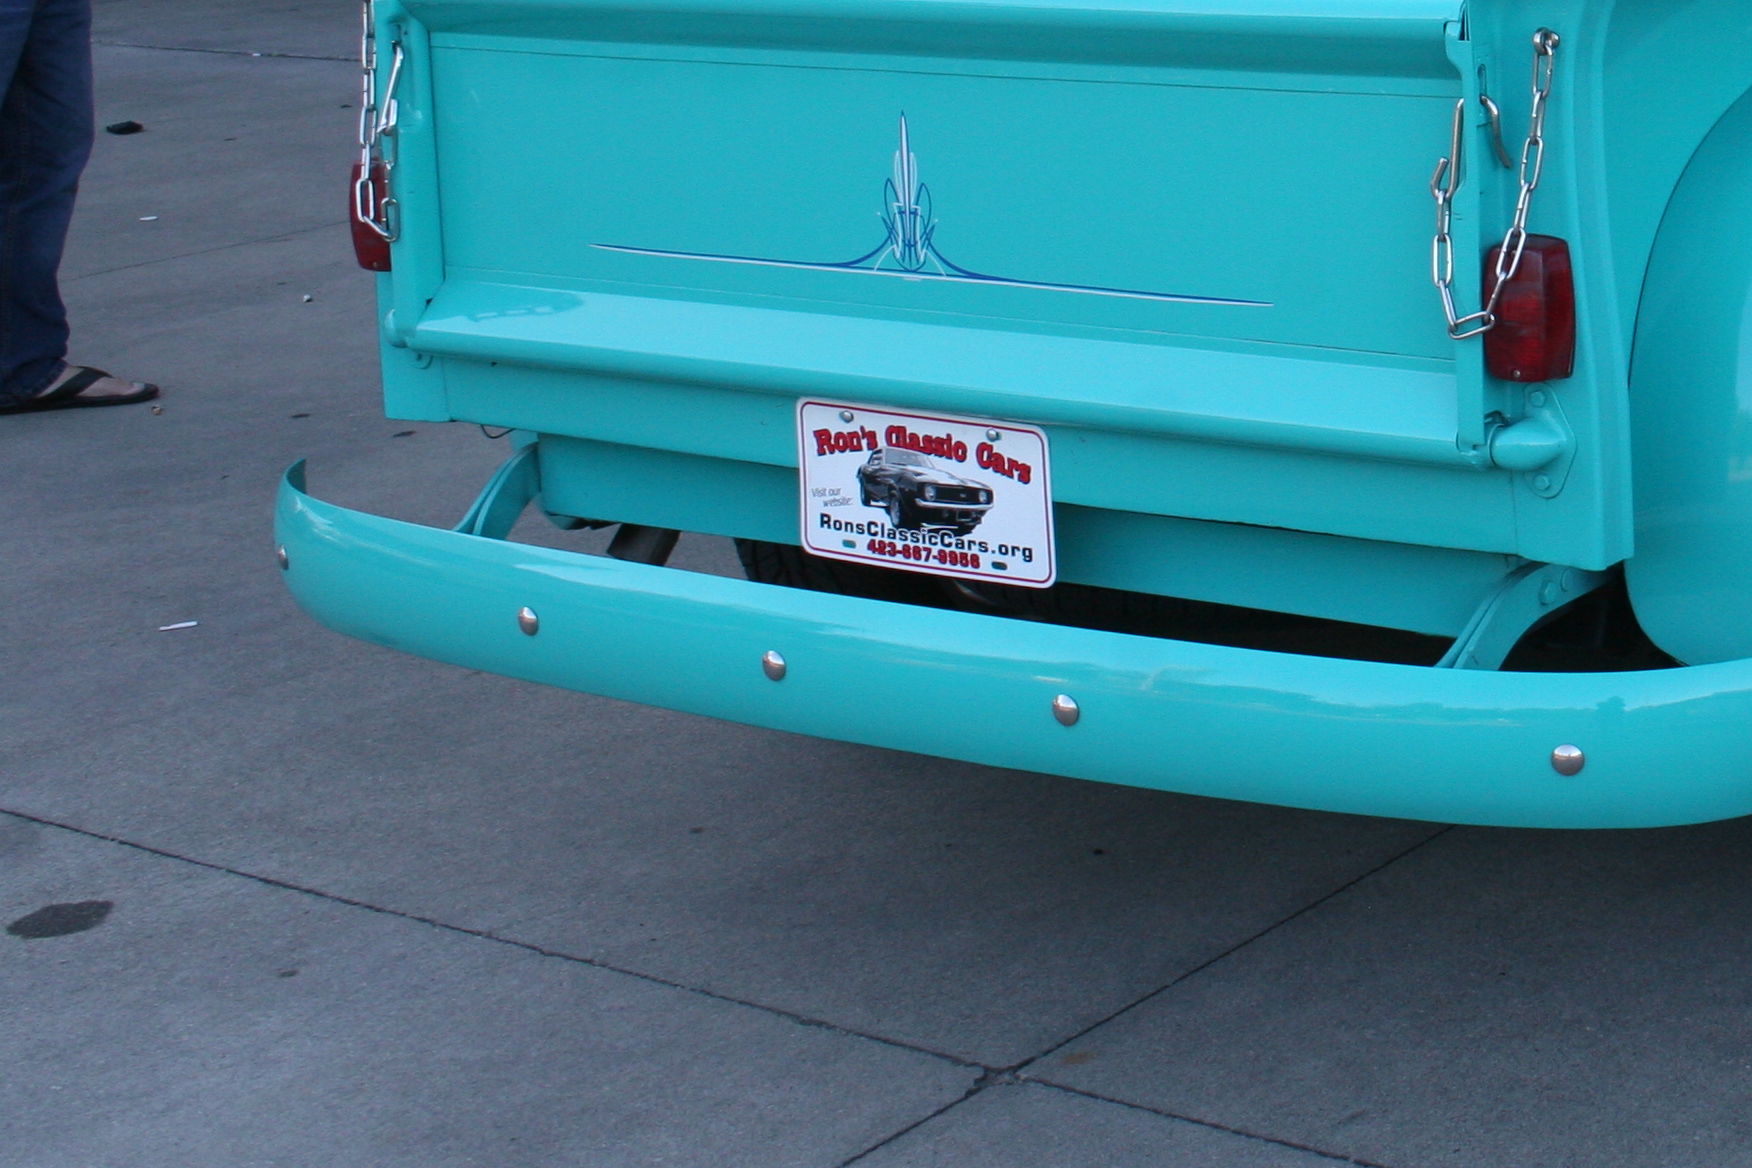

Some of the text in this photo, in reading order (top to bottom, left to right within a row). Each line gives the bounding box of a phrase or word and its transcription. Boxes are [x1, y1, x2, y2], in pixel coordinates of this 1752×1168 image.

[813, 425, 1032, 485] Ron's Classic Cars
[819, 512, 1033, 563] RonsClassicCars.org
